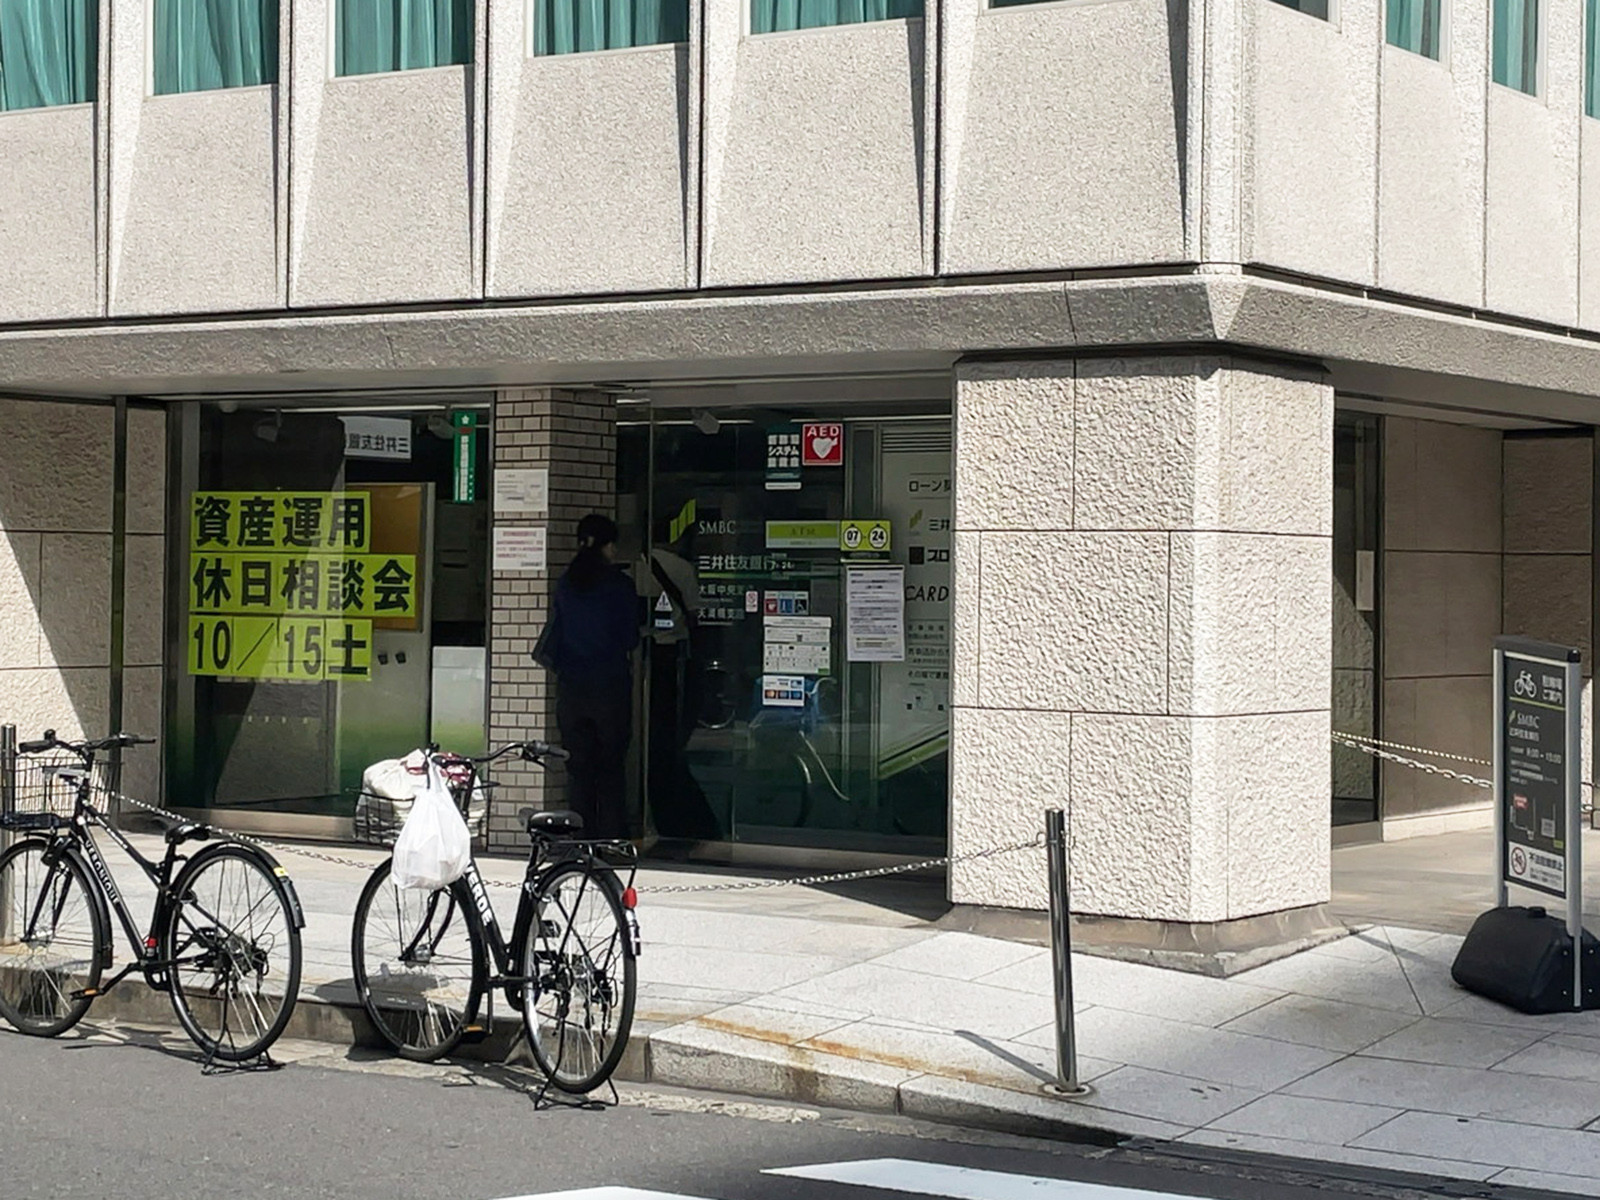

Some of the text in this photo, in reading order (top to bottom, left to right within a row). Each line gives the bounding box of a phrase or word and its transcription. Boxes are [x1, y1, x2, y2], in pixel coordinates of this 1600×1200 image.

[806, 426, 840, 438] AED
[194, 495, 366, 548] 資産運用
[698, 520, 737, 535] SMBC
[192, 557, 414, 613] 休日相談会
[905, 585, 950, 602] CARD
[84, 839, 121, 905] VERONIQUE
